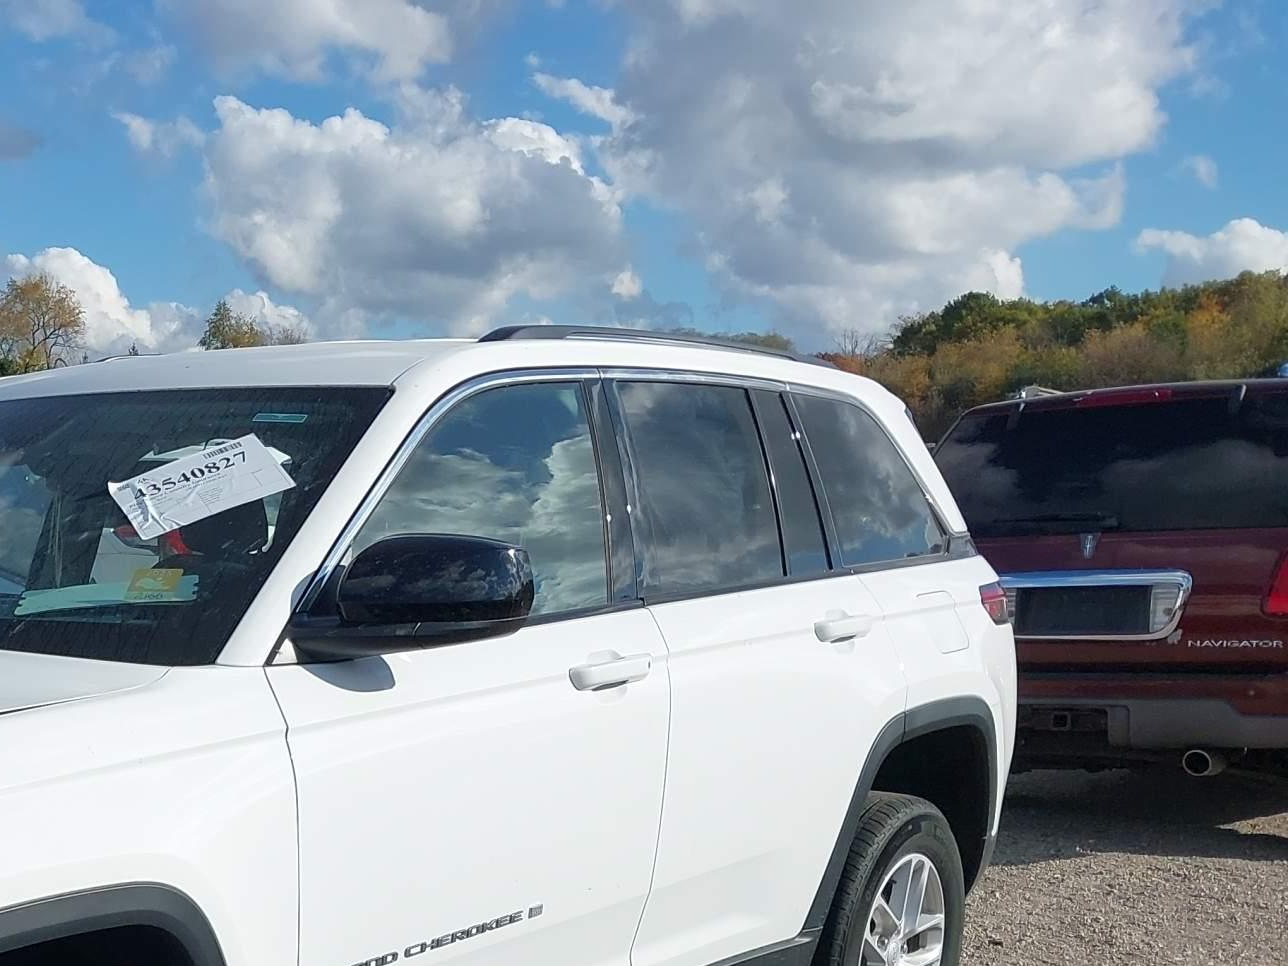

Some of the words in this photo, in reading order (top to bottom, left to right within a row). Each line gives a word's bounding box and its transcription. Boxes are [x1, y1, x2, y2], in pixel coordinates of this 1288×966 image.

[134, 451, 247, 500] 43540827
[1187, 639, 1284, 649] NAVIGATOR
[403, 910, 525, 959] CHEROKEE
